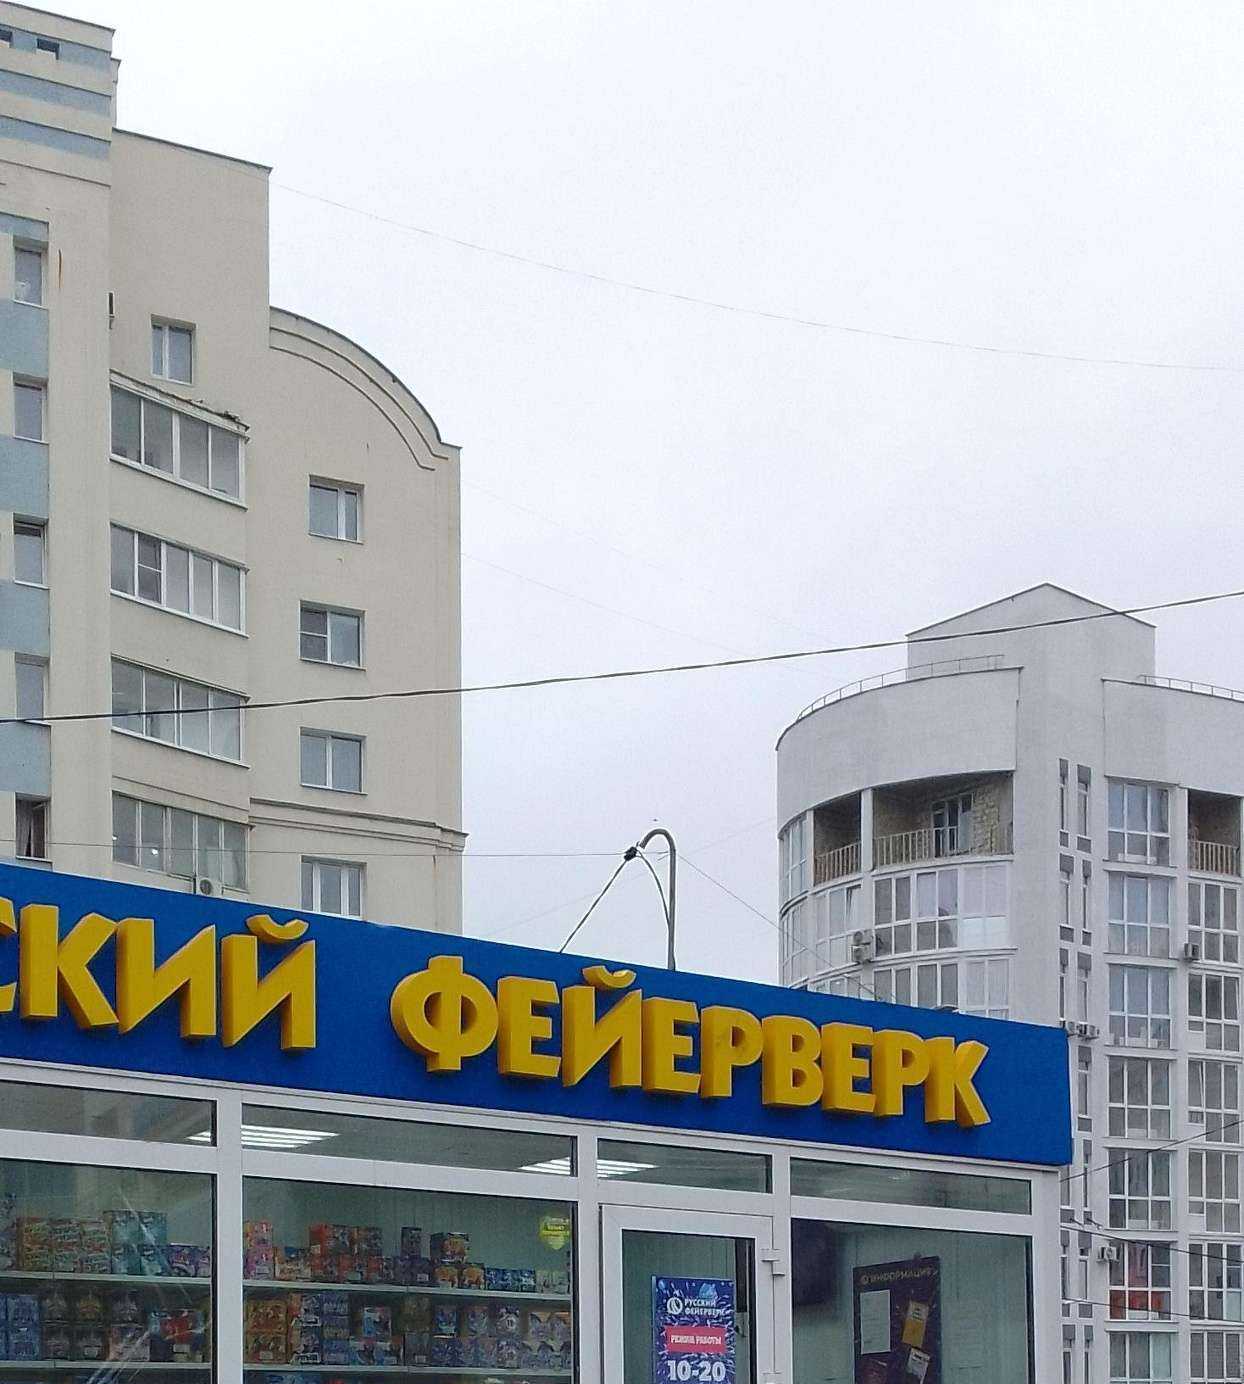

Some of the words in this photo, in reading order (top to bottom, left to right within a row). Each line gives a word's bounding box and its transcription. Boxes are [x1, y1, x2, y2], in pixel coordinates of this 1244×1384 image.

[0, 896, 316, 1050] КИЙ
[390, 955, 989, 1127] ФЕЙЕРВЕРК
[684, 1298, 716, 1307] РУССКИЙ
[684, 1307, 726, 1316] ФЕЙЕРВЕРК
[696, 1335, 722, 1345] РАБОТЫ
[667, 1360, 726, 1381] 10-20
